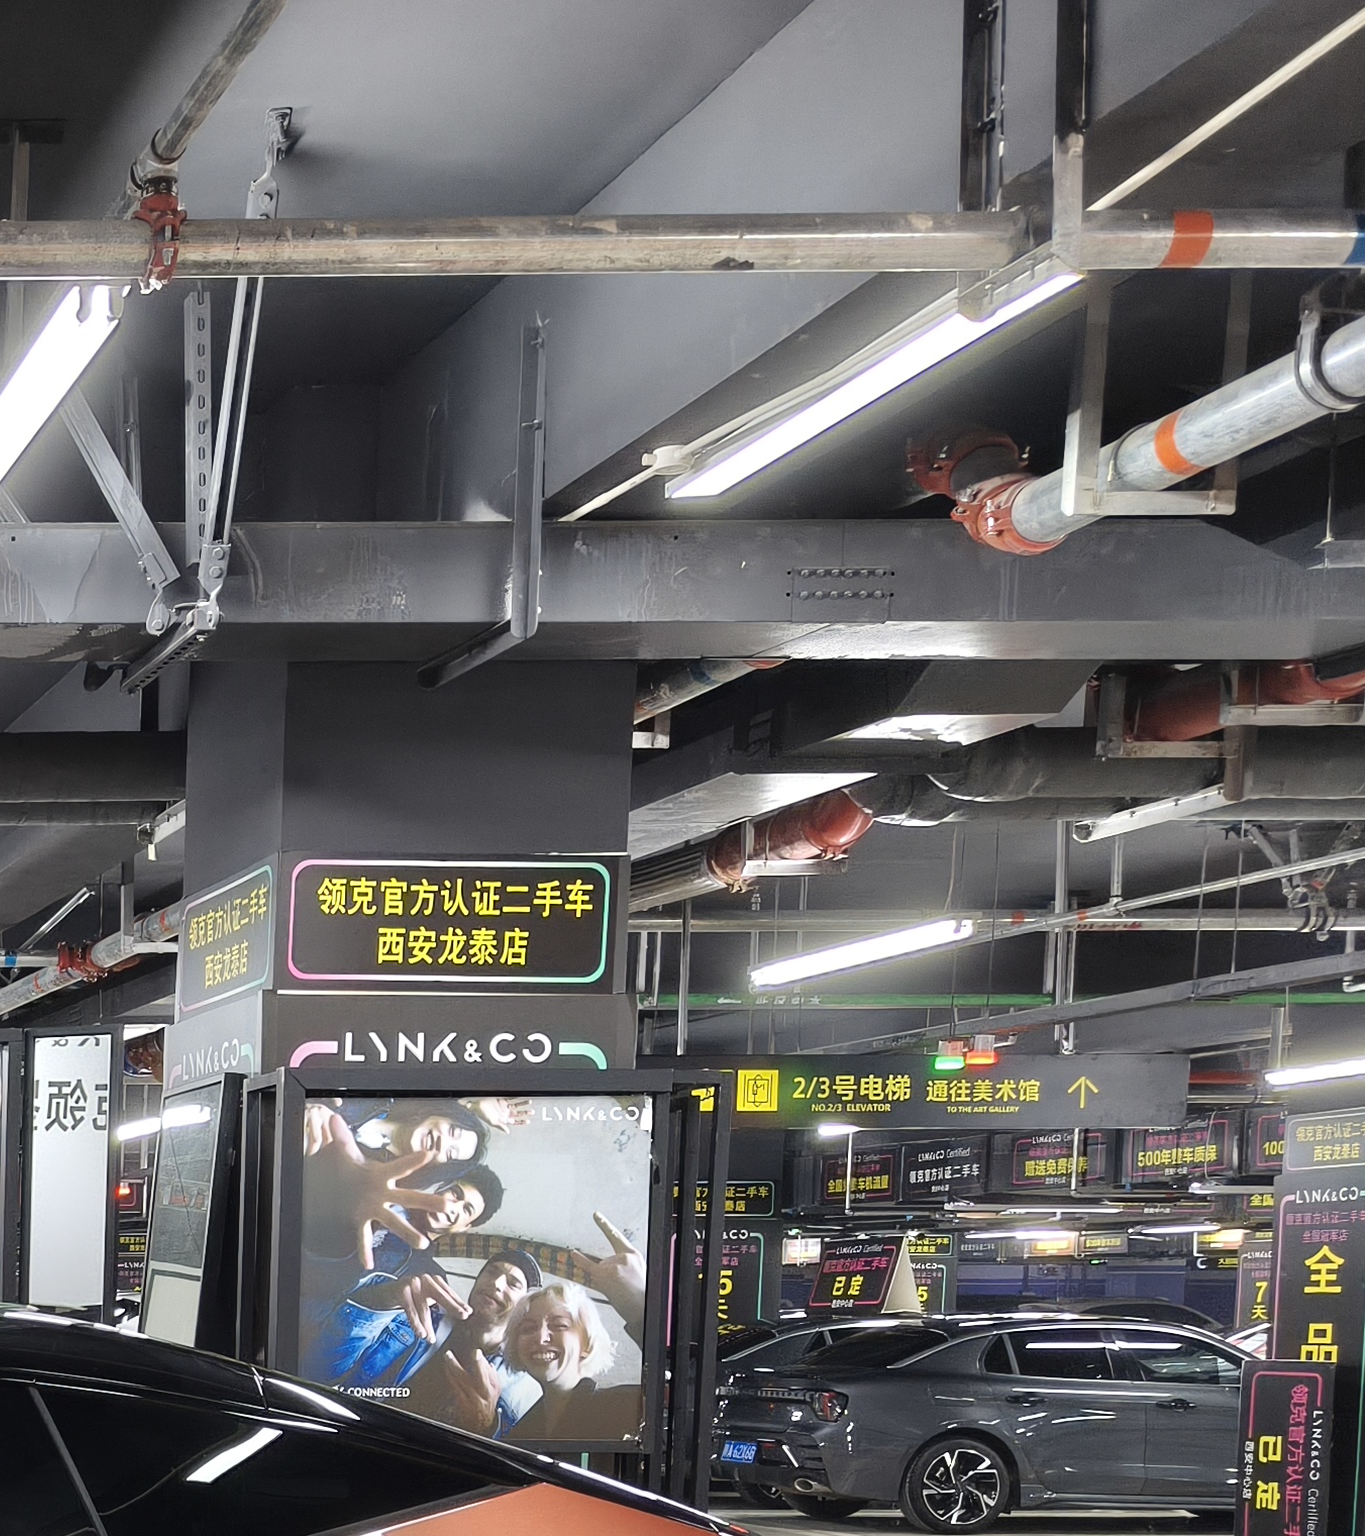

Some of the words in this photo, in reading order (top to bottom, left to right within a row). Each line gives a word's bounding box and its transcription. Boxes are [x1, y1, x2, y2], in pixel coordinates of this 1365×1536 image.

[189, 884, 268, 950] 领克官方认证二手车
[317, 878, 594, 917] 领克官方认证二手车
[204, 939, 249, 989] 西安龙泰店
[376, 927, 530, 966] 西安龙泰店
[181, 1038, 240, 1081] LYNK&CO
[343, 1031, 553, 1064] LYNK&CO
[792, 1074, 911, 1102] 2/3号电梯
[926, 1078, 1040, 1102] 通往美术馆
[541, 1106, 640, 1121] LYNK&CO
[846, 1103, 891, 1113] ELEVATOR
[946, 1105, 957, 1114] TO
[958, 1105, 971, 1114] THE
[972, 1105, 987, 1114] ART
[988, 1105, 1019, 1114] GALLERY
[1295, 1187, 1359, 1204] LYNK&CO
[347, 1387, 411, 1398] CONNECTED
[1309, 1410, 1323, 1481] LYNK&CO
[1242, 1441, 1255, 1500] 西安中心店
[1255, 1435, 1283, 1511] 已定
